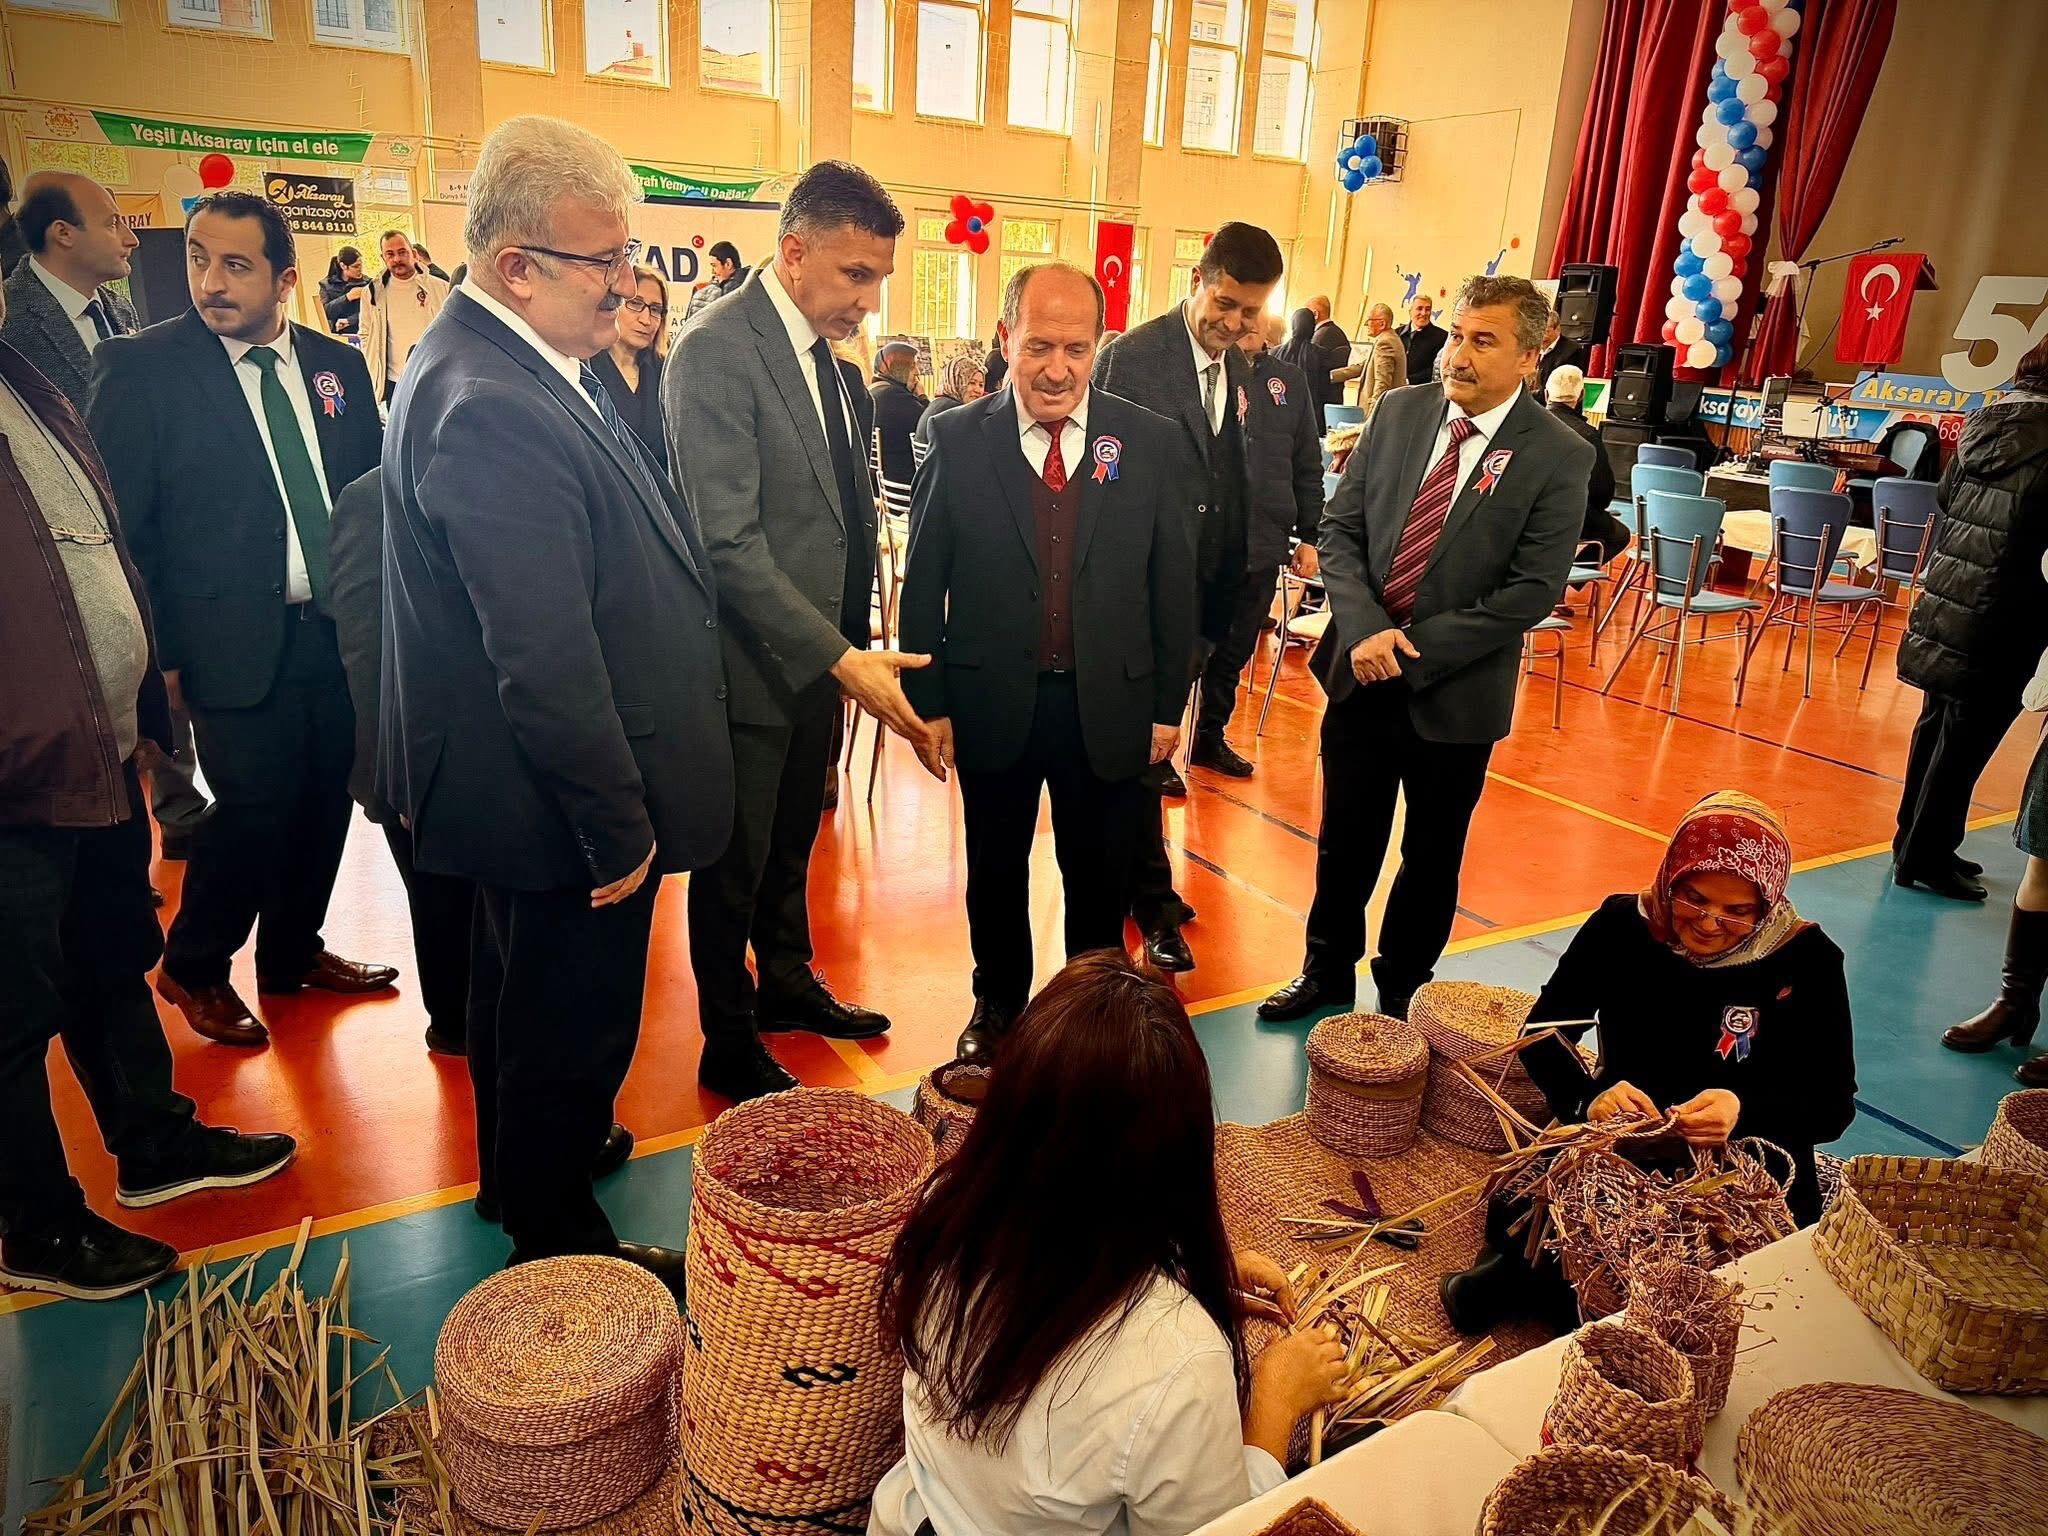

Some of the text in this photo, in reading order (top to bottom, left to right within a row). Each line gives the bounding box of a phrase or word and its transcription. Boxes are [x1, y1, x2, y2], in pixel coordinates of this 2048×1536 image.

[130, 123, 176, 146] Yeşil
[180, 129, 252, 154] Aksaray
[292, 139, 308, 154] el
[312, 140, 339, 155] ele
[293, 183, 353, 208] Aksaray
[121, 212, 152, 228] ARAY
[281, 204, 354, 221] ganizasyon
[302, 220, 324, 231] 844
[326, 221, 355, 233] 8110
[1860, 379, 1970, 410] Aksaray
